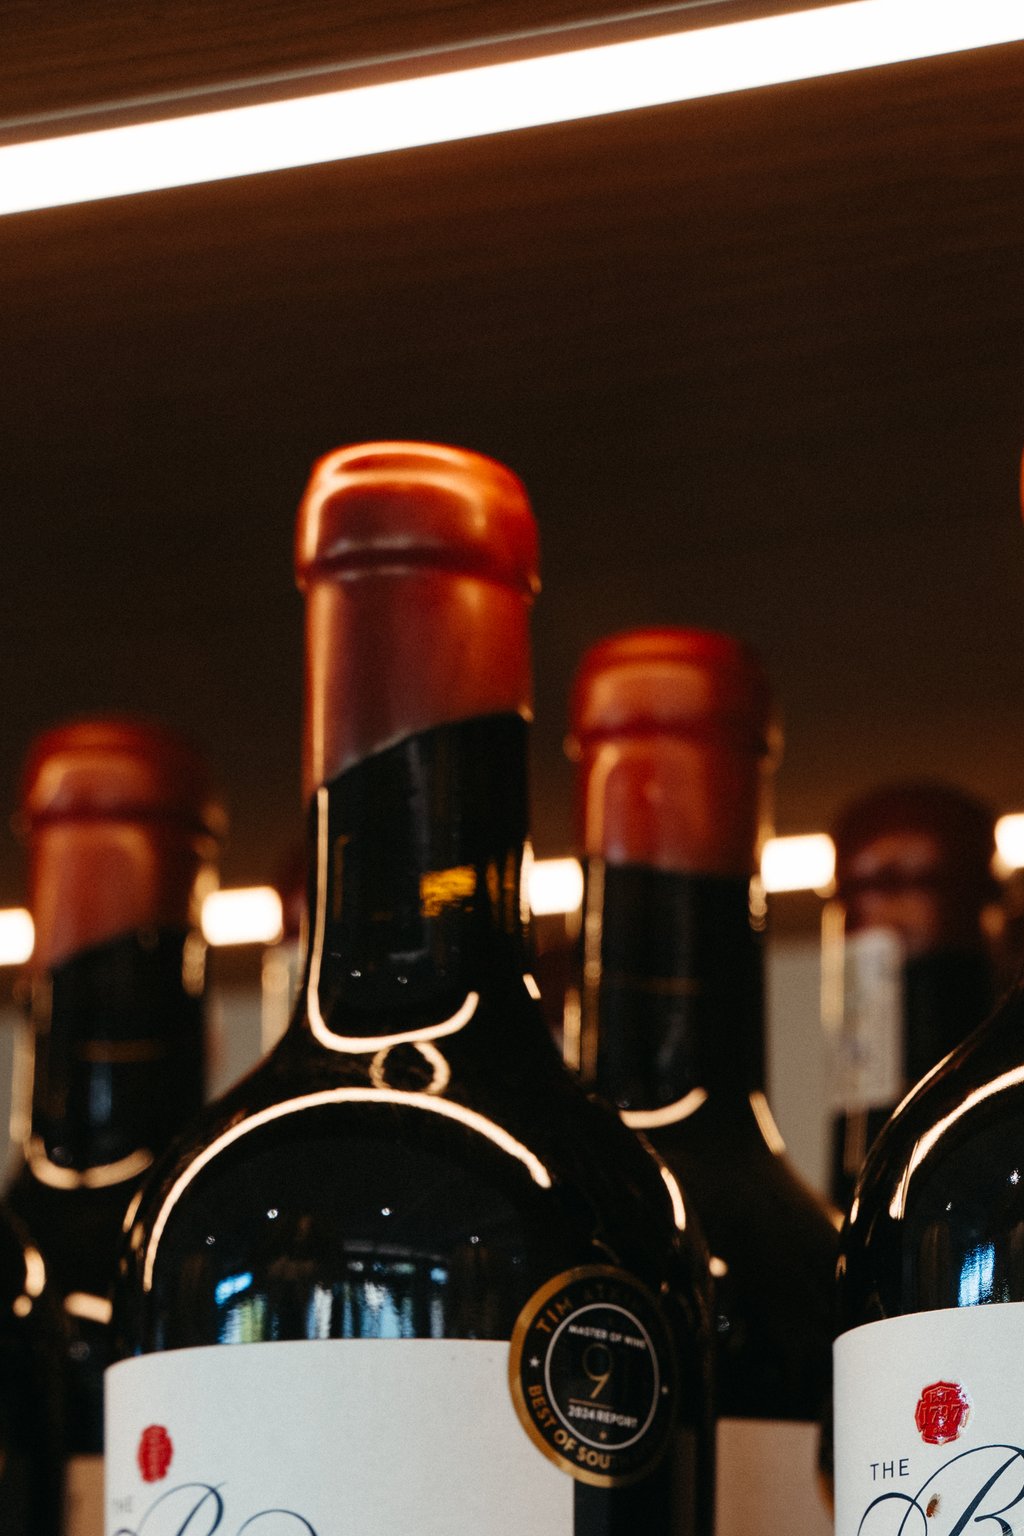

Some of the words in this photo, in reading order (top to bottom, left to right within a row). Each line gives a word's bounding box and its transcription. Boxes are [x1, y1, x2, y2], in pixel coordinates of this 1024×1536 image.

[536, 1299, 574, 1333] TIM
[528, 1384, 558, 1429] BEST
[553, 1429, 577, 1452] OF
[576, 1446, 611, 1469] SOU
[869, 1458, 910, 1481] THE
